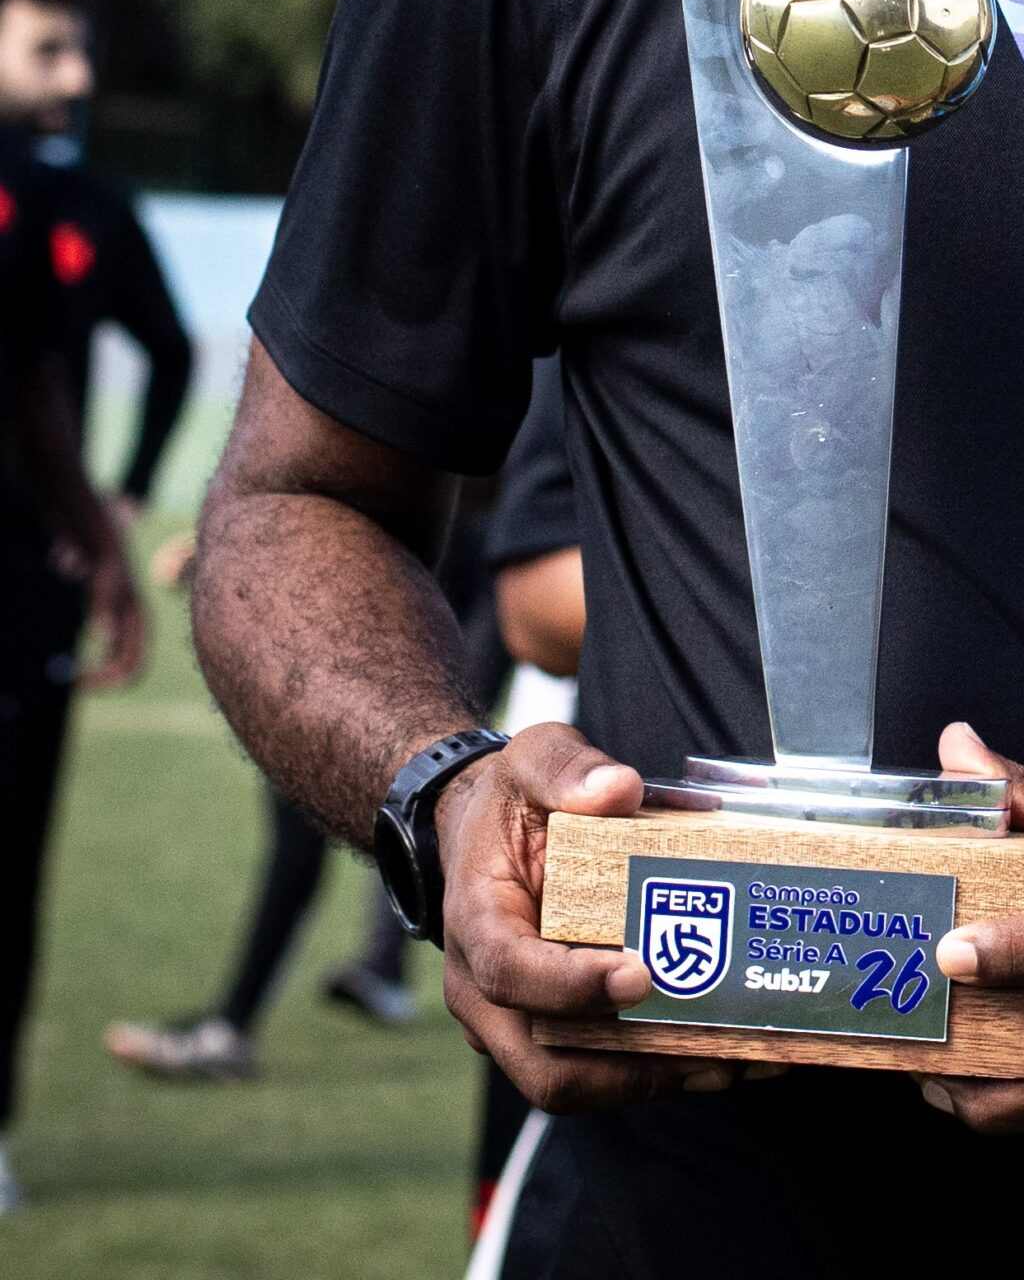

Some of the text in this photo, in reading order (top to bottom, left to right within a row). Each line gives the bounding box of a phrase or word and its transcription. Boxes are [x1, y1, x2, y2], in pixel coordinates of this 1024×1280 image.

[651, 888, 724, 914] FERJ
[748, 881, 860, 906] Campeão
[747, 904, 932, 941] ESTADUAL
[747, 937, 849, 966] Série A
[745, 965, 831, 994] Sub17
[850, 947, 931, 1016] 26
